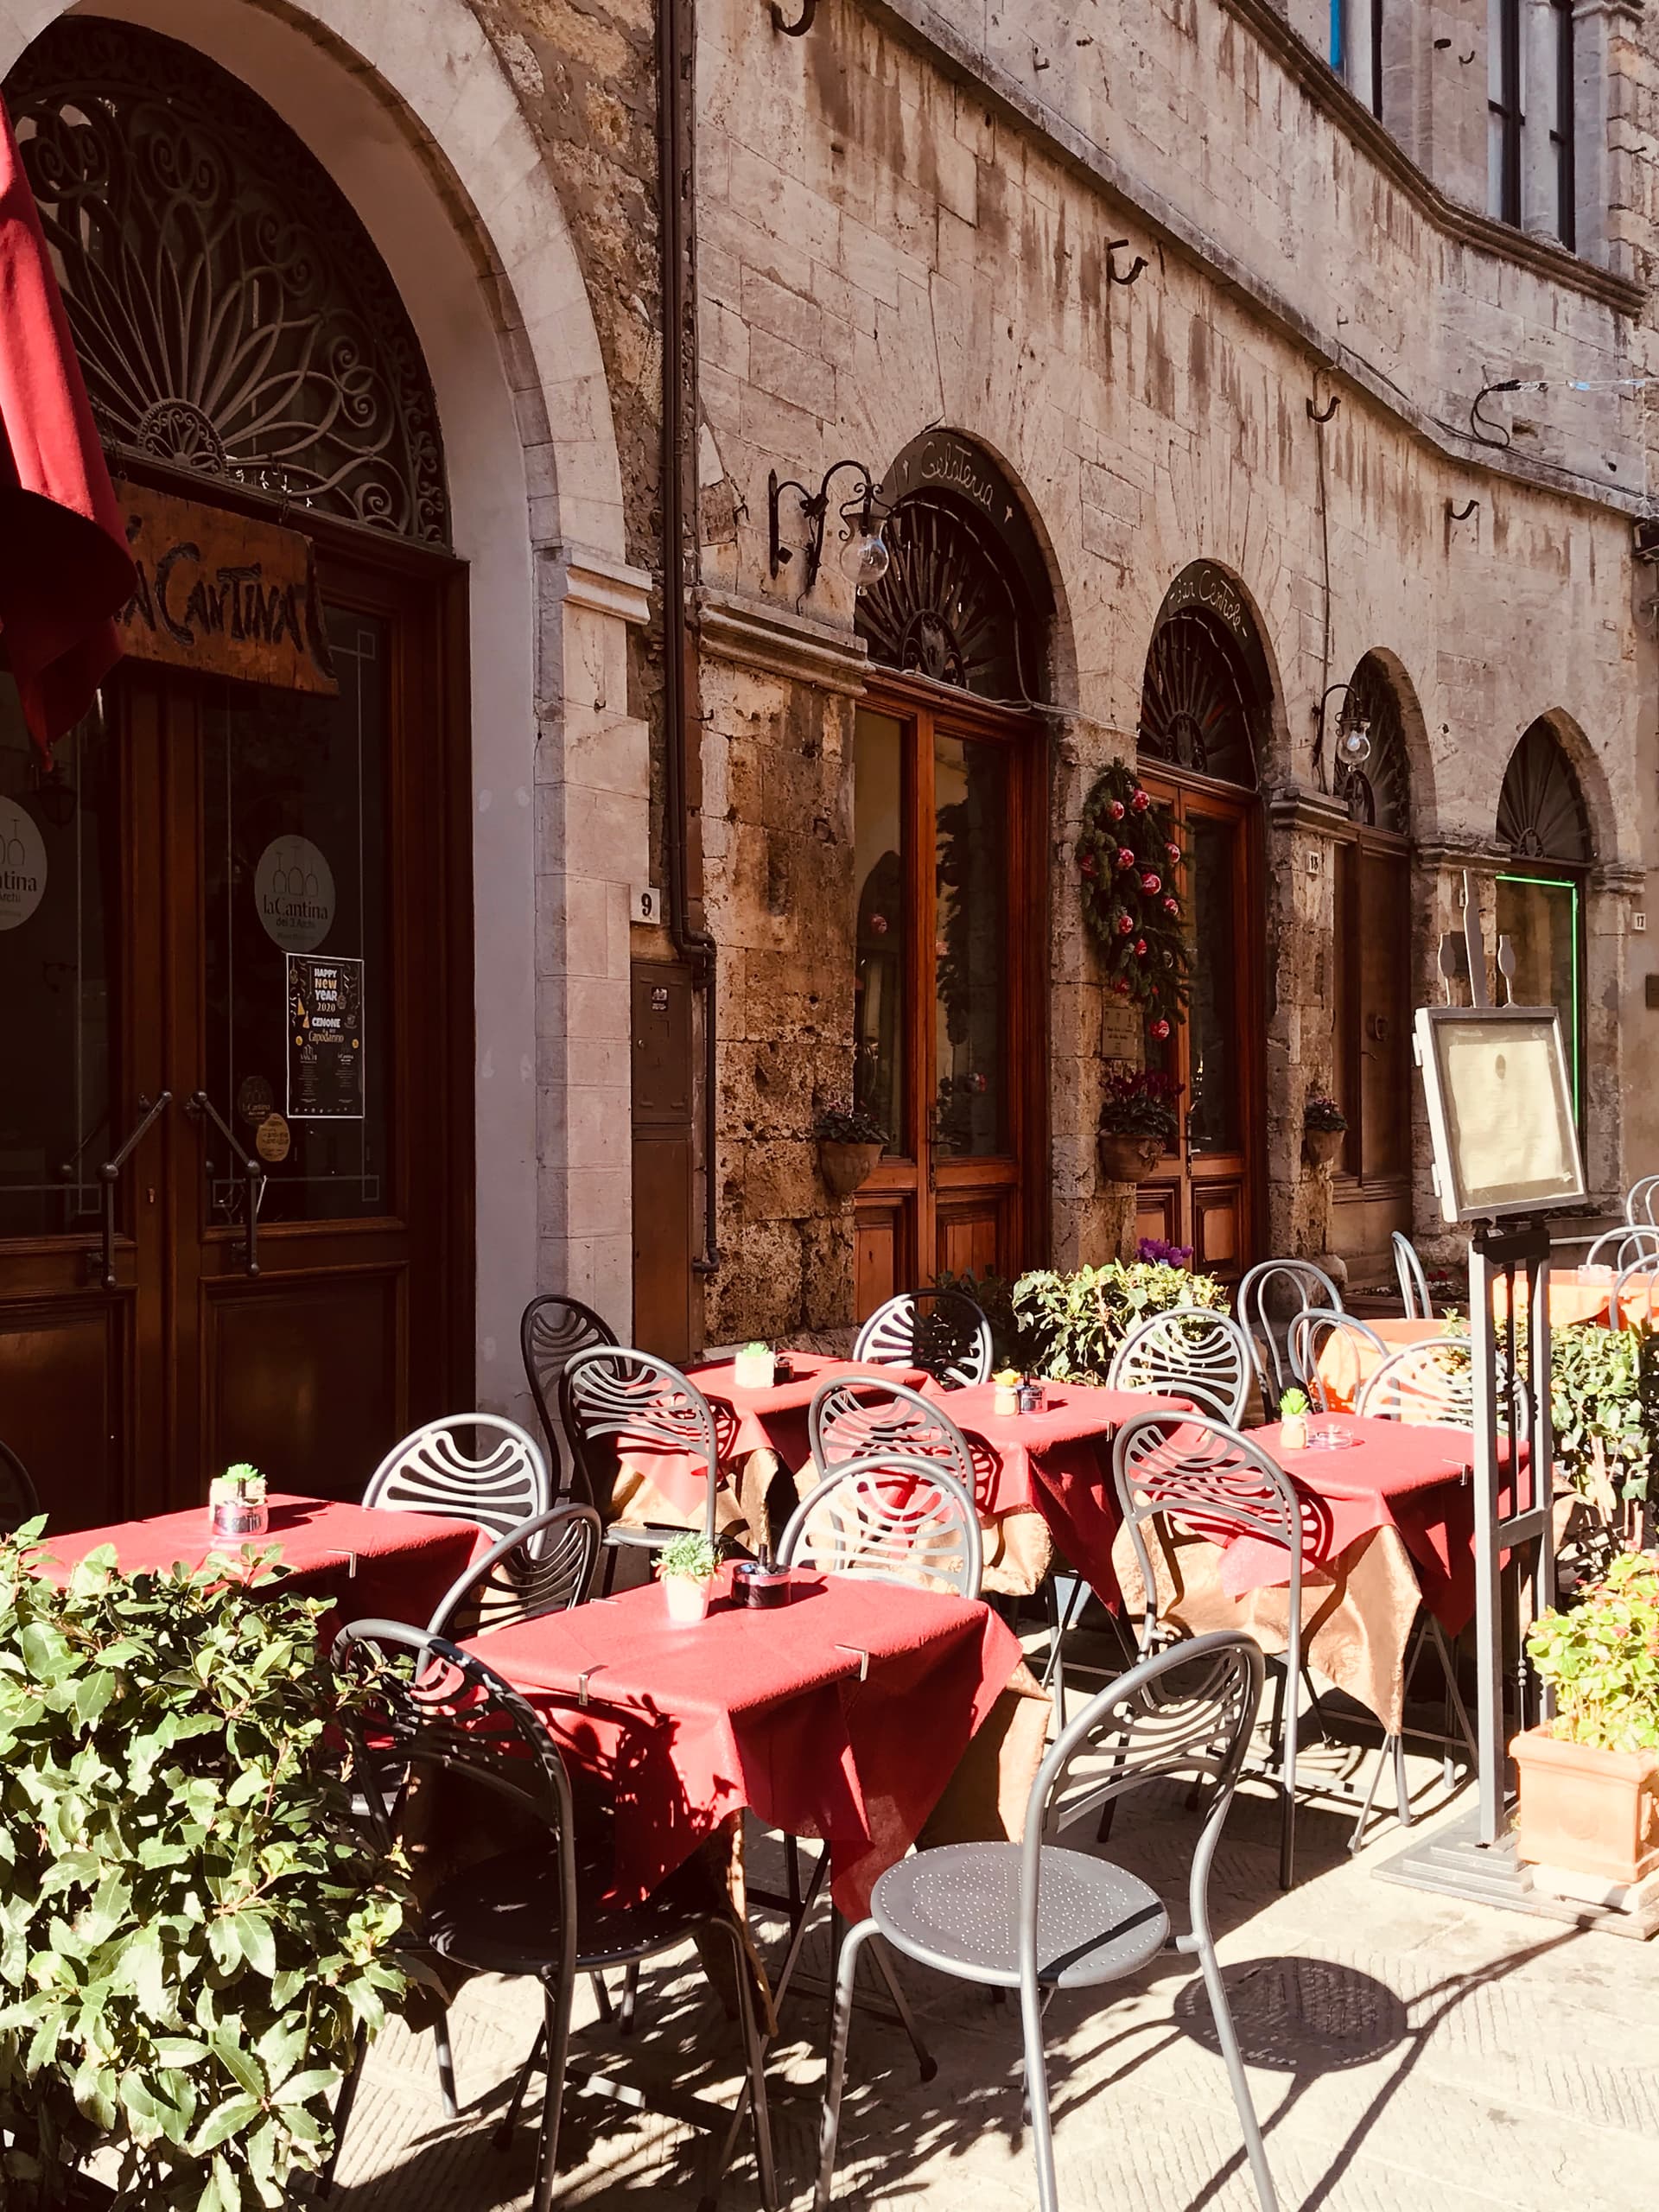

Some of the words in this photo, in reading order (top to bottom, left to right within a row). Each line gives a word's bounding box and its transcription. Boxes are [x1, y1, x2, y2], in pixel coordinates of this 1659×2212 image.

[641, 893, 652, 917] 9
[314, 968, 338, 978] HAPPY
[316, 1002, 336, 1013] 2020
[312, 1017, 341, 1028] CENONE
